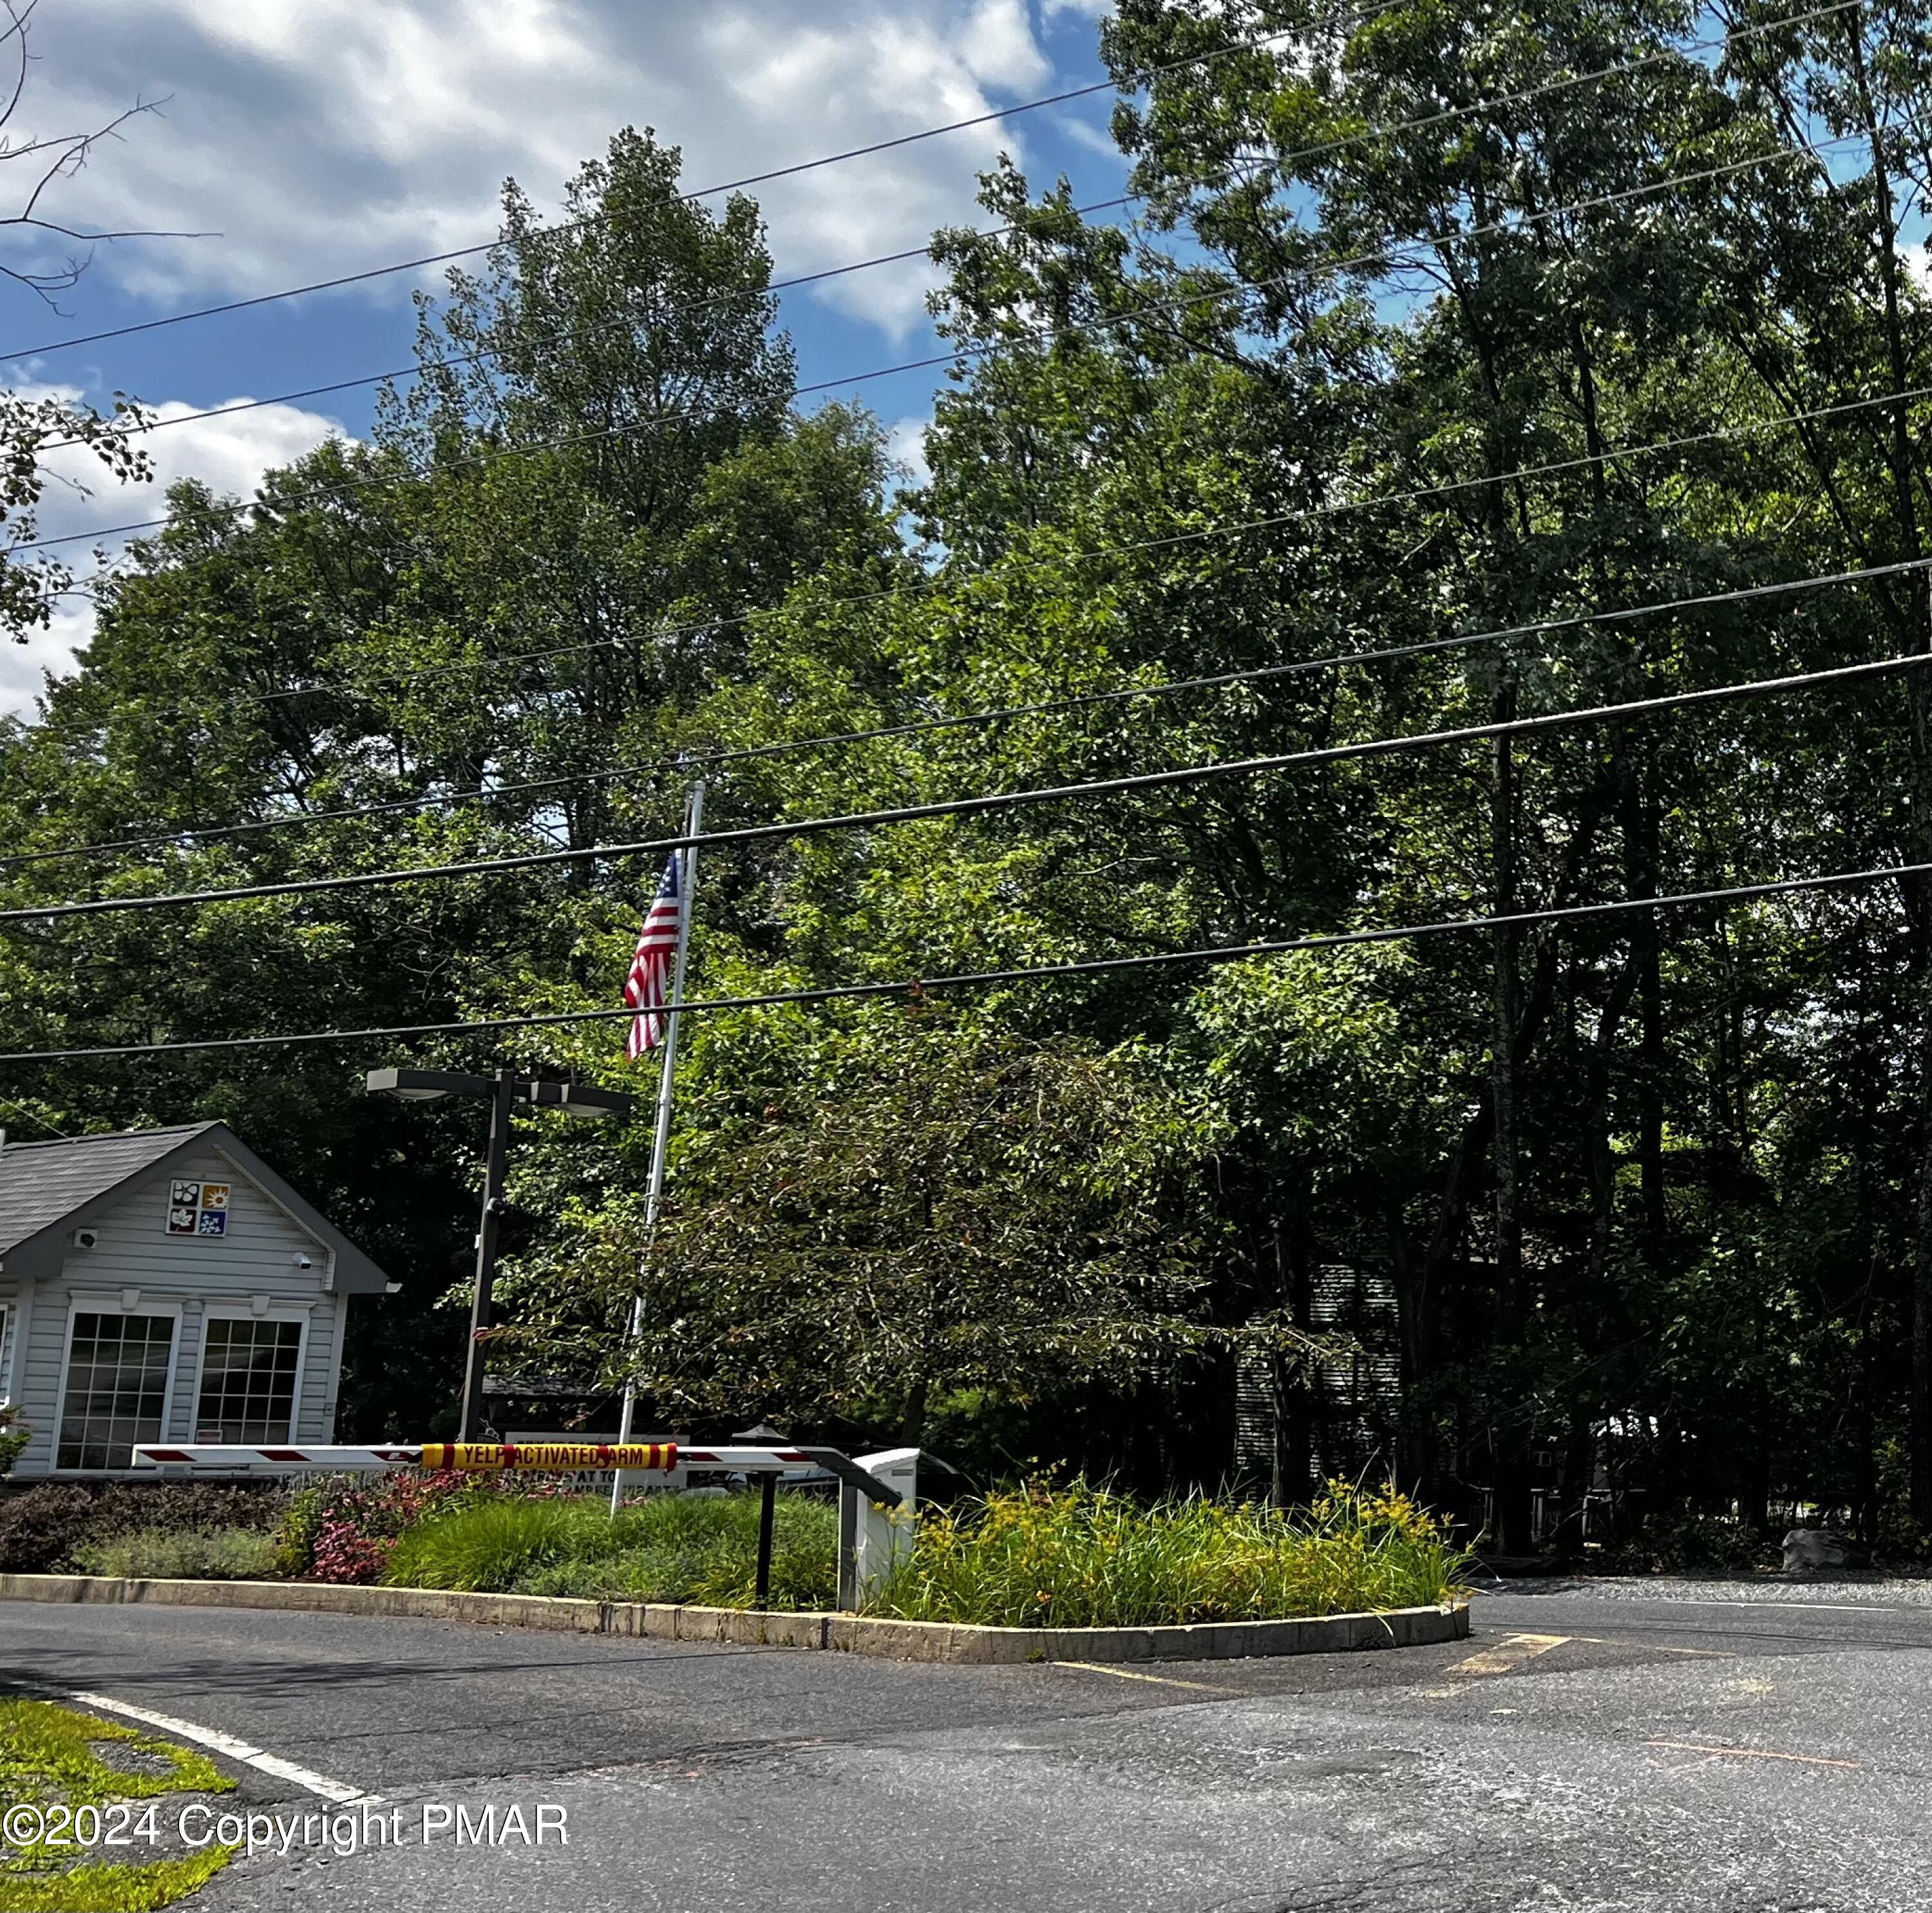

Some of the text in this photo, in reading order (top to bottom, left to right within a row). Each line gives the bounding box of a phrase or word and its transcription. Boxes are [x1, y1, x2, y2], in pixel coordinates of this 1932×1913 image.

[464, 1446, 643, 1465] YELP ACTIVATED ARM
[577, 1471, 596, 1482] AT
